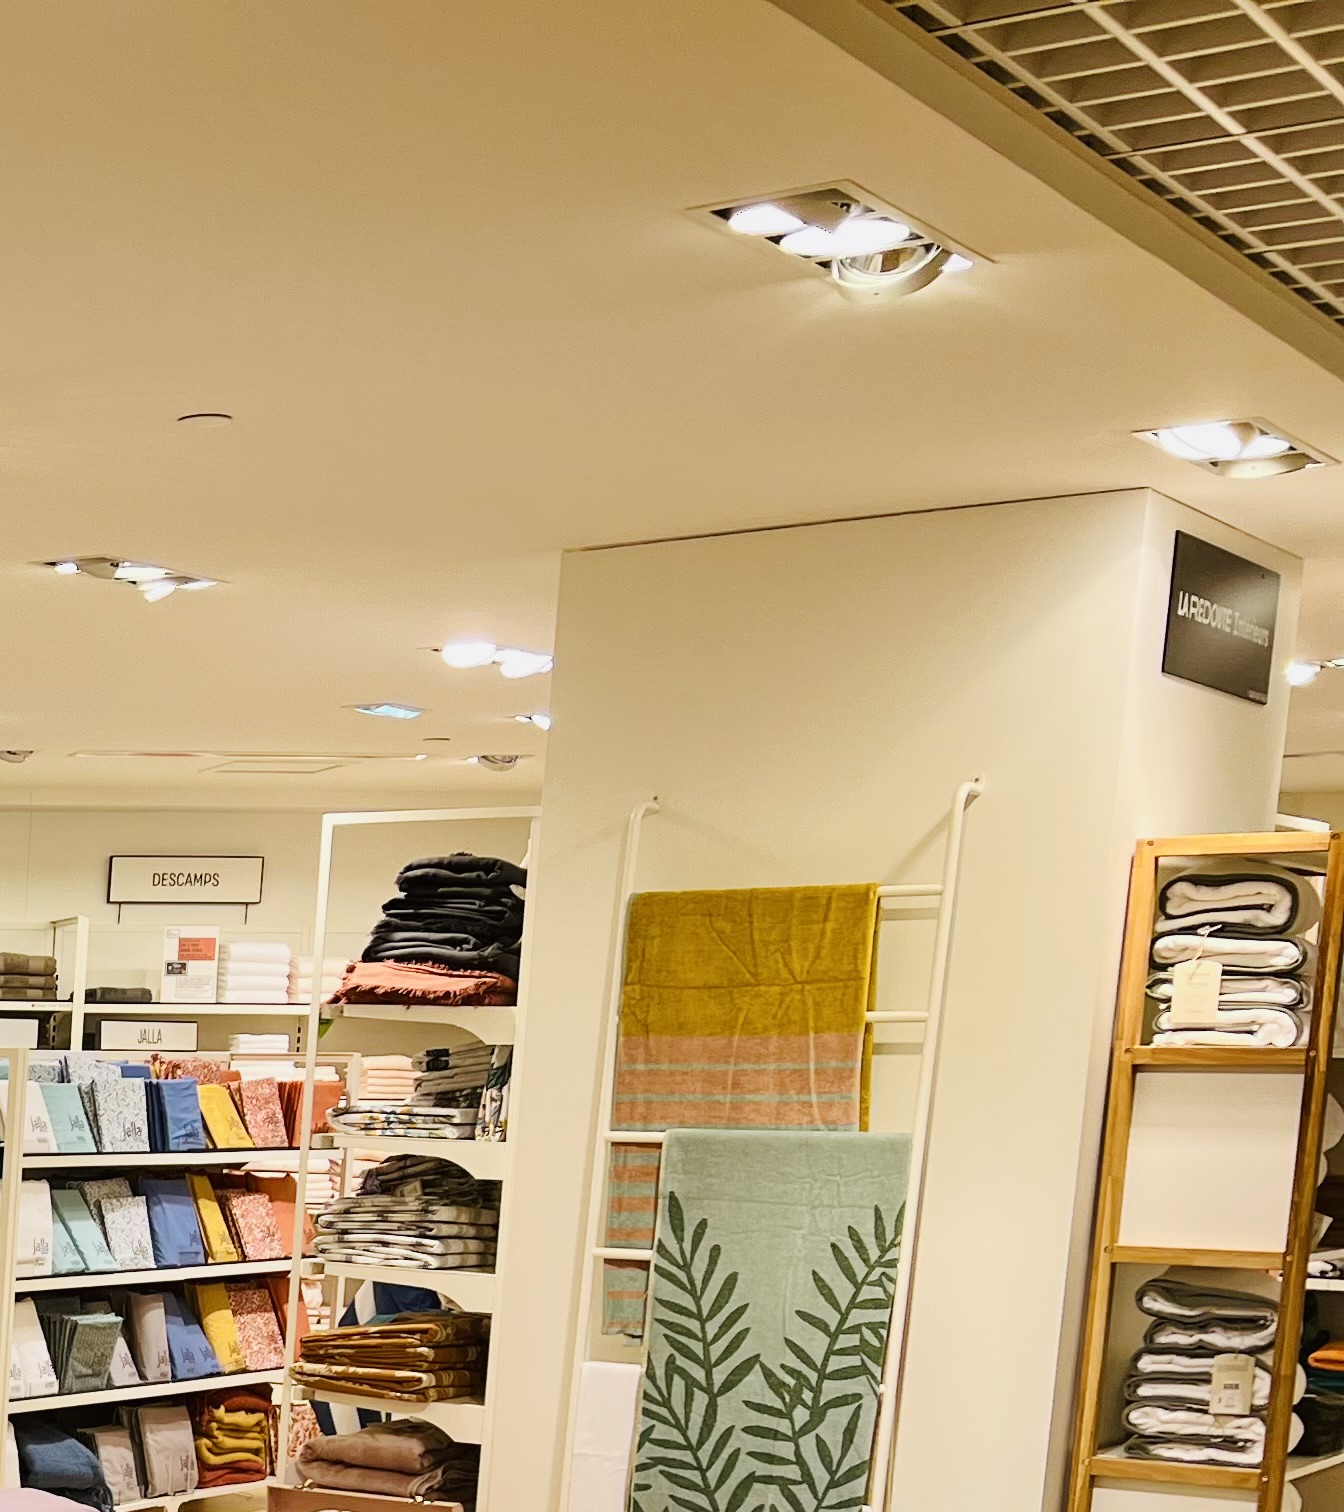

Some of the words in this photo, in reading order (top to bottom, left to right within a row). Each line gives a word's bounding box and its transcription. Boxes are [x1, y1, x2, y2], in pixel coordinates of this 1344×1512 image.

[1177, 591, 1189, 618] LA
[1189, 595, 1232, 633] REDOUTE
[152, 872, 220, 887] DESCAMPS
[137, 1028, 162, 1044] JALLA
